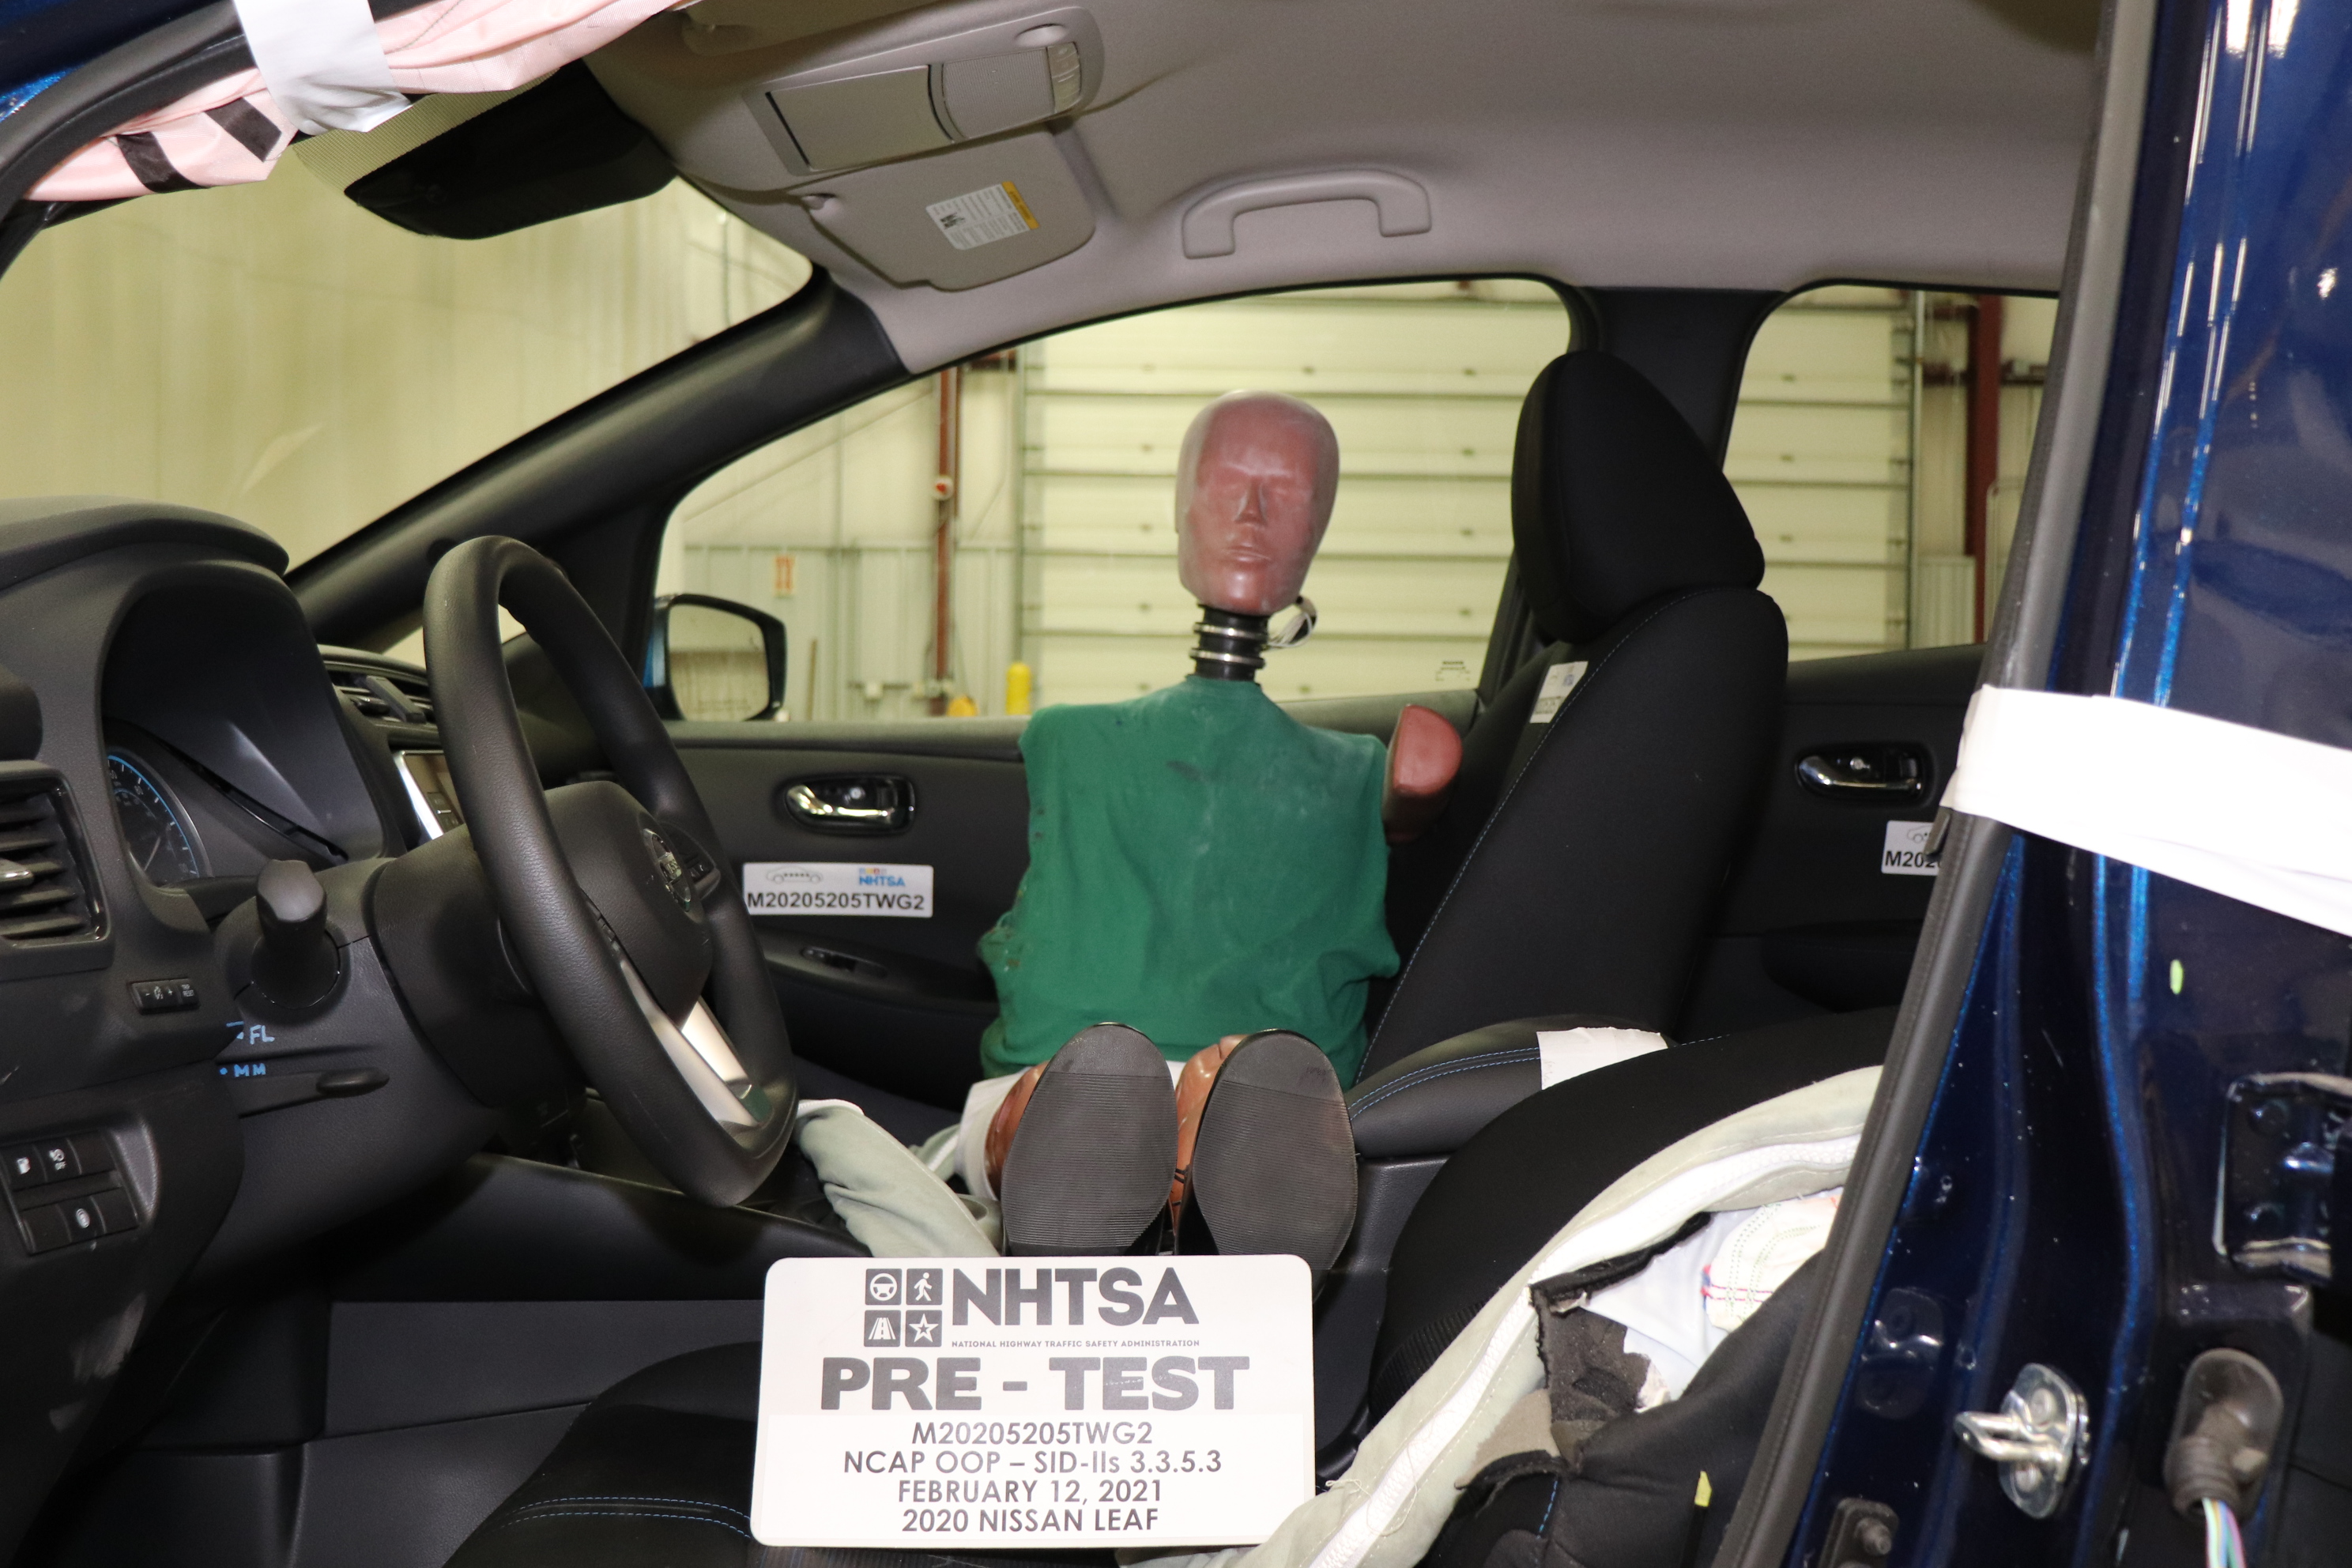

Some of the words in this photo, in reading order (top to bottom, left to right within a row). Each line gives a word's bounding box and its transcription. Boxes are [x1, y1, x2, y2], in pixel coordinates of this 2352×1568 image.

[858, 876, 906, 888] NHTSA
[748, 892, 925, 910] M20205205TWG2
[250, 1024, 276, 1045] FL
[952, 1266, 1200, 1327] NHTSA
[821, 1356, 982, 1411] PRE
[1049, 1355, 1250, 1412] TEST
[911, 1421, 1152, 1446] M20205205TWG2
[844, 1450, 925, 1474] NCAP
[936, 1450, 1001, 1474] OOP
[1034, 1450, 1120, 1474] SID-IIs
[1130, 1449, 1222, 1473] 3.3.5.3
[899, 1479, 1038, 1503] FEBRUARY
[1050, 1479, 1087, 1506] 12,
[1098, 1479, 1160, 1502] 2021
[902, 1509, 969, 1532] 2020
[979, 1508, 1083, 1532] NISSAN
[1095, 1508, 1159, 1532] LEAF
